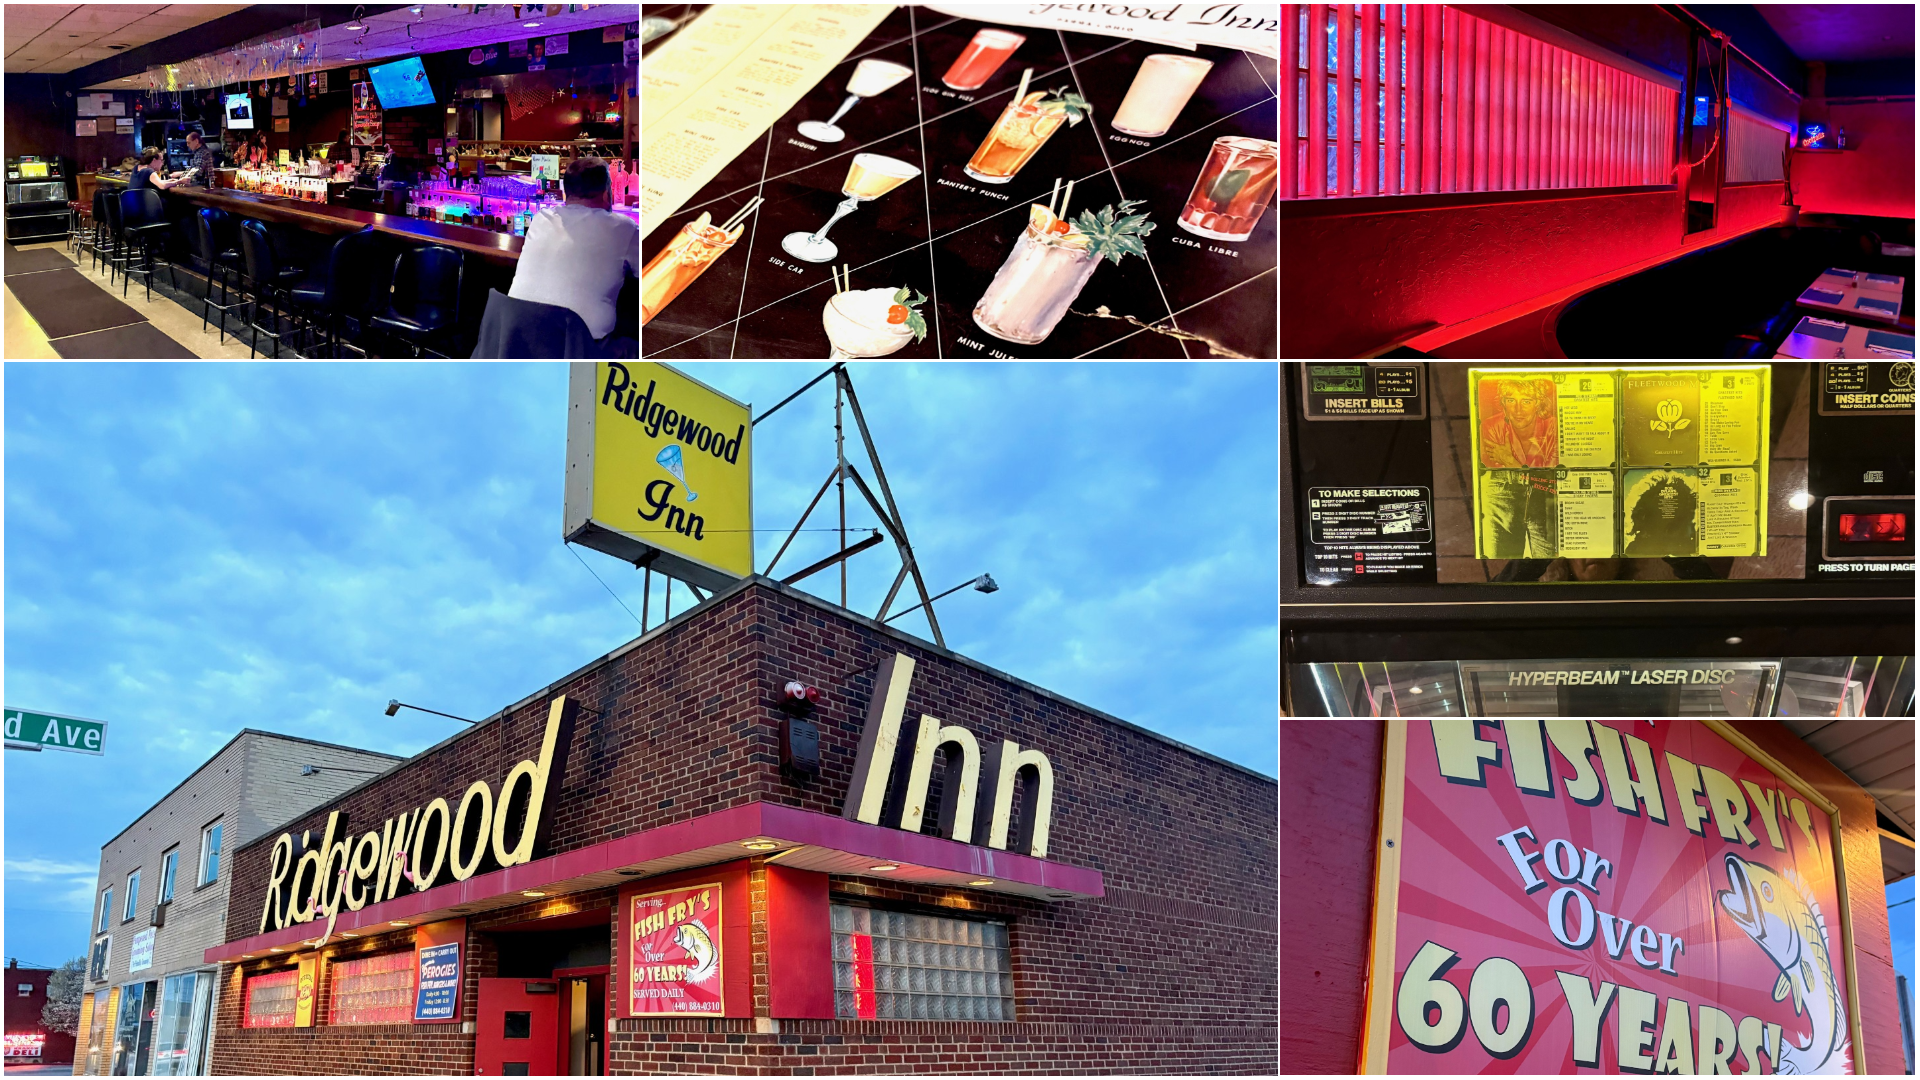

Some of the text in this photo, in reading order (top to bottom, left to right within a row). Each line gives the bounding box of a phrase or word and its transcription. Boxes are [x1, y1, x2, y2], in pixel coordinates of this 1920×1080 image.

[1187, 4, 1277, 31] Inn
[485, 52, 498, 61] Blue
[788, 138, 818, 152] DAIQUIRI
[1109, 135, 1151, 147] EGG NOG
[936, 178, 1010, 201] PLANTER'S PUNCH
[1172, 237, 1239, 258] CUBA LIBRE
[768, 256, 805, 275] SIDE CAR
[957, 336, 986, 352] MINT
[1555, 375, 1565, 384] 29
[1628, 380, 1686, 389] FLEETWOOD
[1325, 398, 1404, 408] INSERT BILLS
[1836, 394, 1915, 404] INSERT COINS
[602, 363, 745, 465] Ridgewood
[1699, 469, 1708, 477] 32
[1318, 489, 1420, 498] TO MAKE SELECTIONS
[638, 480, 704, 541] Inn
[1818, 563, 1915, 572] PRESS TO TURN PAGE
[1631, 670, 1688, 685] LASER
[1691, 669, 1736, 685] DISC
[41, 719, 100, 749] Ave
[857, 652, 1054, 858] Inn
[1430, 720, 1819, 860] FISH FRY'S
[259, 694, 567, 949] Ridgewood
[1496, 826, 1613, 895] For
[634, 890, 711, 942] FISH FRY'S
[1547, 887, 1685, 976] Over
[641, 942, 654, 955] For
[645, 951, 665, 963] Over
[422, 963, 456, 979] PEROGIES
[634, 965, 688, 983] 60 YEARS!
[634, 988, 685, 999] SERVED DAILY
[672, 1002, 720, 1012] (440) 884-0310
[1397, 940, 1783, 1075] 60 YEARS!
